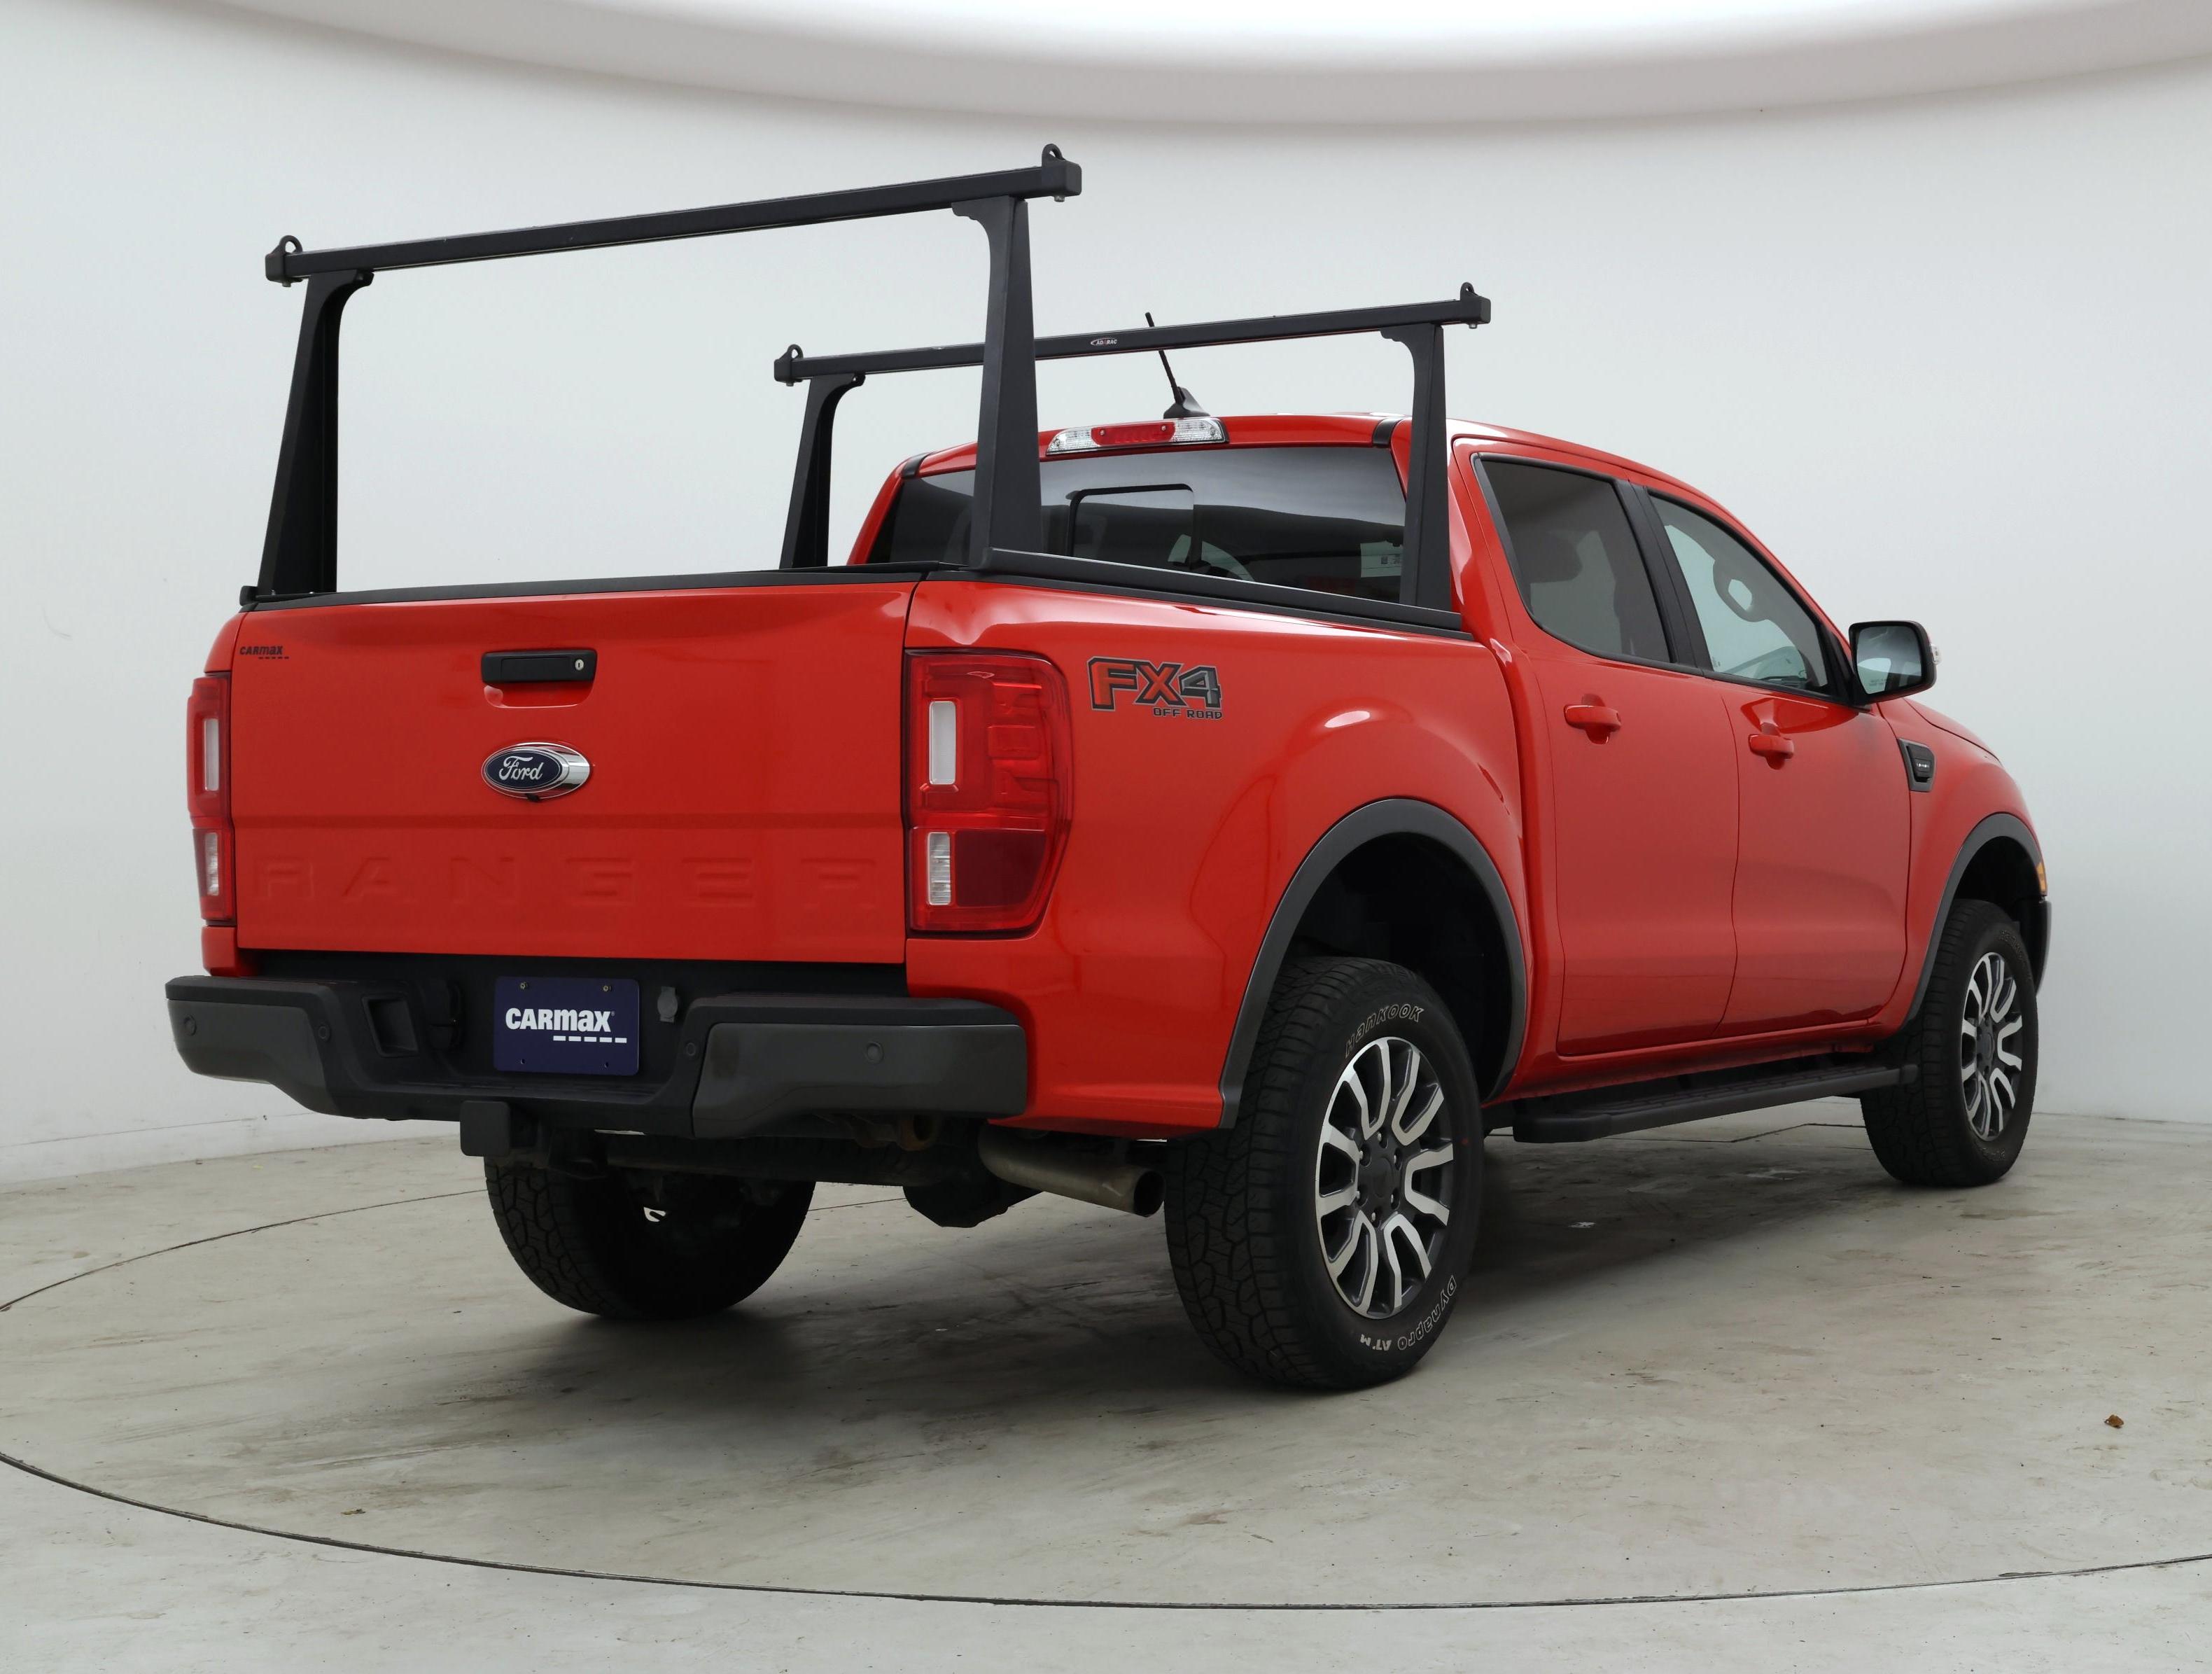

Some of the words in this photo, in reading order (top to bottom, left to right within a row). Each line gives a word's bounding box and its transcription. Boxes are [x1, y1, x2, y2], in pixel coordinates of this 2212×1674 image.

[1087, 656, 1222, 712] FX4
[1154, 708, 1181, 717] OFF
[1186, 709, 1222, 720] ROAD
[498, 755, 544, 780] Ford
[254, 856, 878, 908] RANGER
[505, 1007, 611, 1033] CARmax
